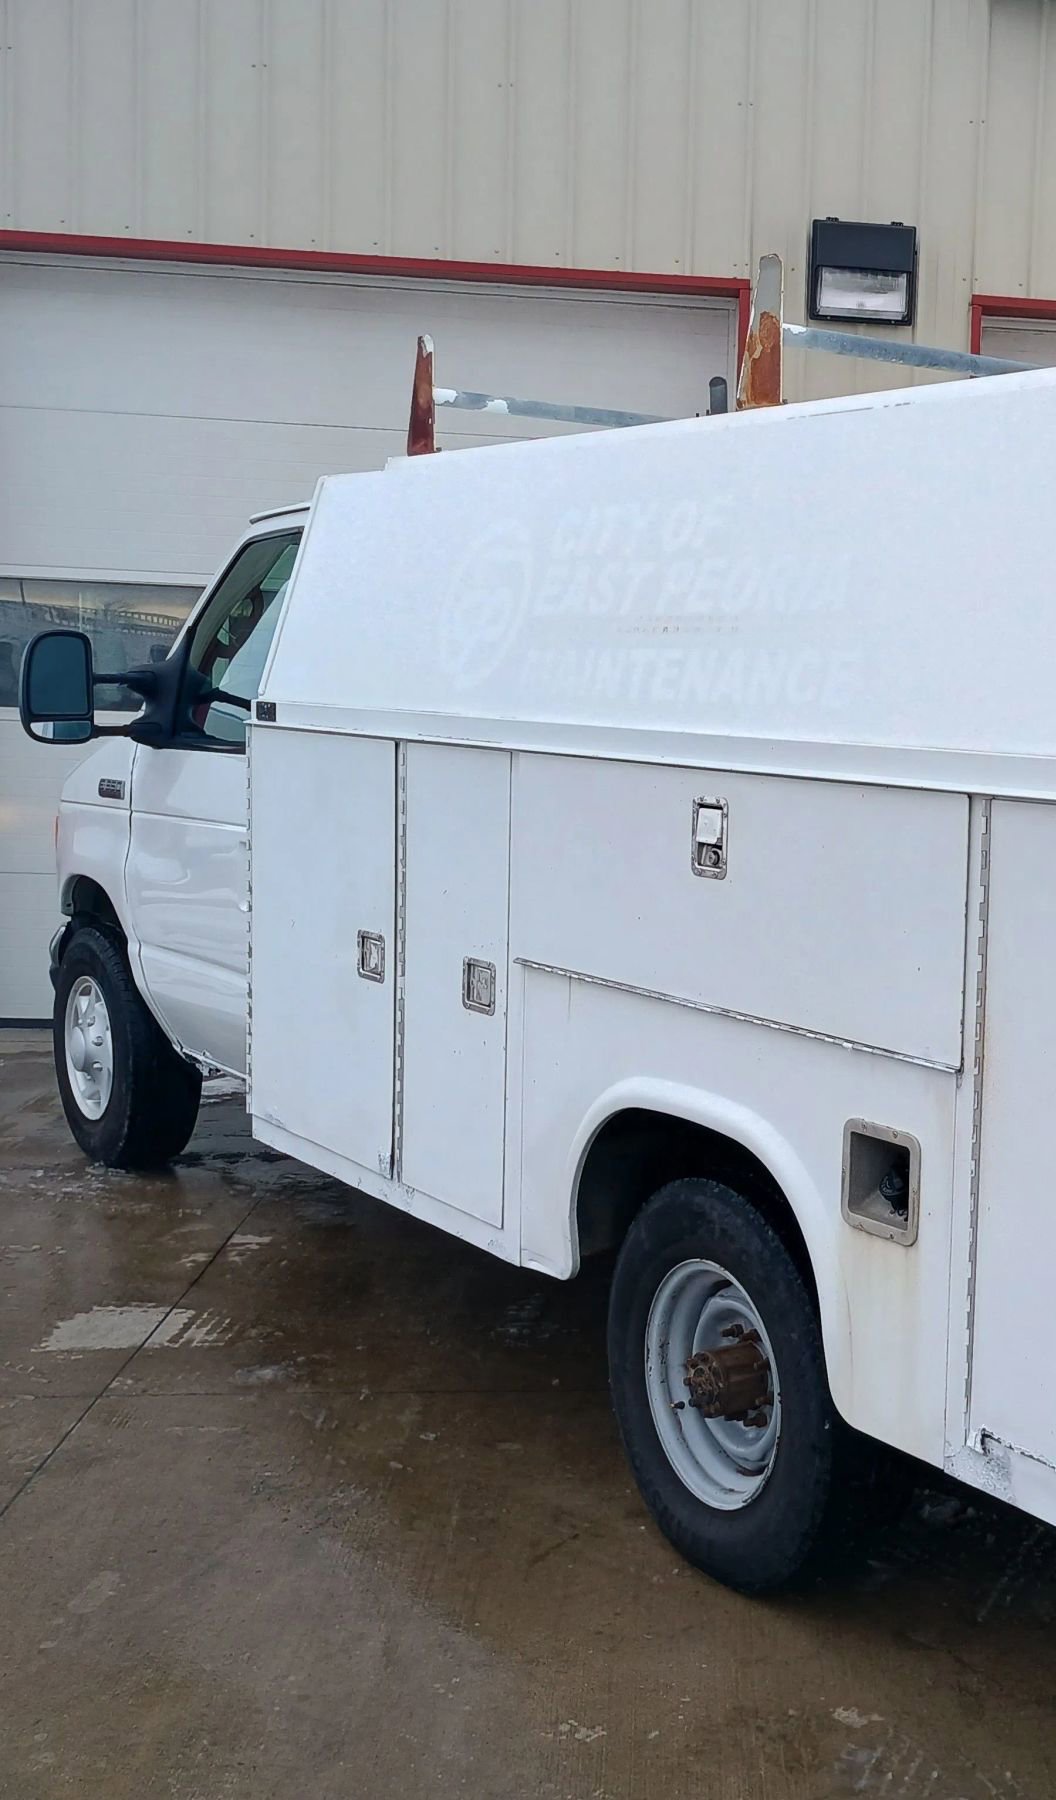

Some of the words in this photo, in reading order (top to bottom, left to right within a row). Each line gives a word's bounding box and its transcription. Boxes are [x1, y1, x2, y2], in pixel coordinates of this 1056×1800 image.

[551, 501, 658, 558] CITY
[661, 495, 736, 554] OF
[533, 562, 656, 616] EAST
[655, 553, 855, 614] PEORIA
[519, 648, 864, 708] MAINTENANCE
